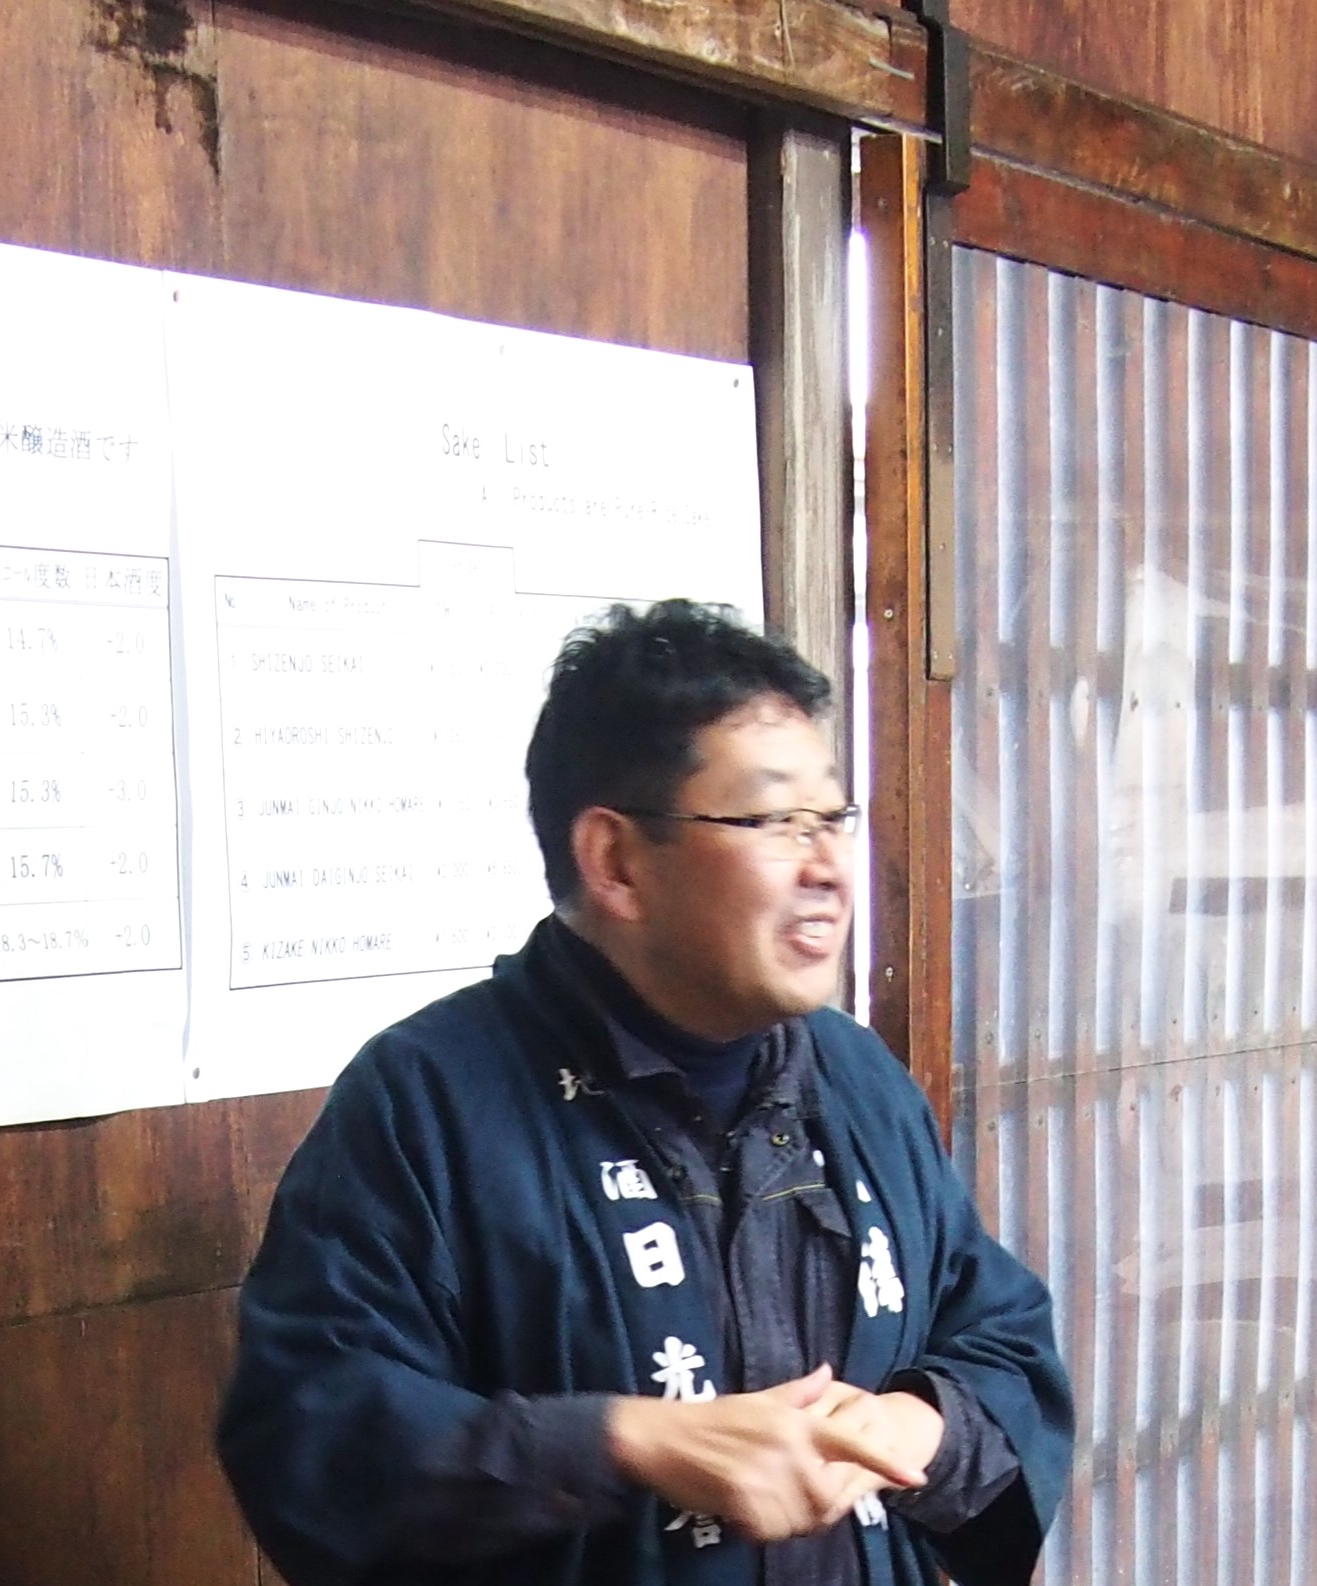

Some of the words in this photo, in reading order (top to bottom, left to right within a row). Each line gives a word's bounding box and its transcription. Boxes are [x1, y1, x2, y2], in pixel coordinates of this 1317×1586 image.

[441, 422, 481, 460] Sake
[503, 431, 550, 468] List
[9, 702, 62, 728] 15.3%
[10, 778, 62, 804] 15.3%
[10, 853, 64, 879] 15.7%
